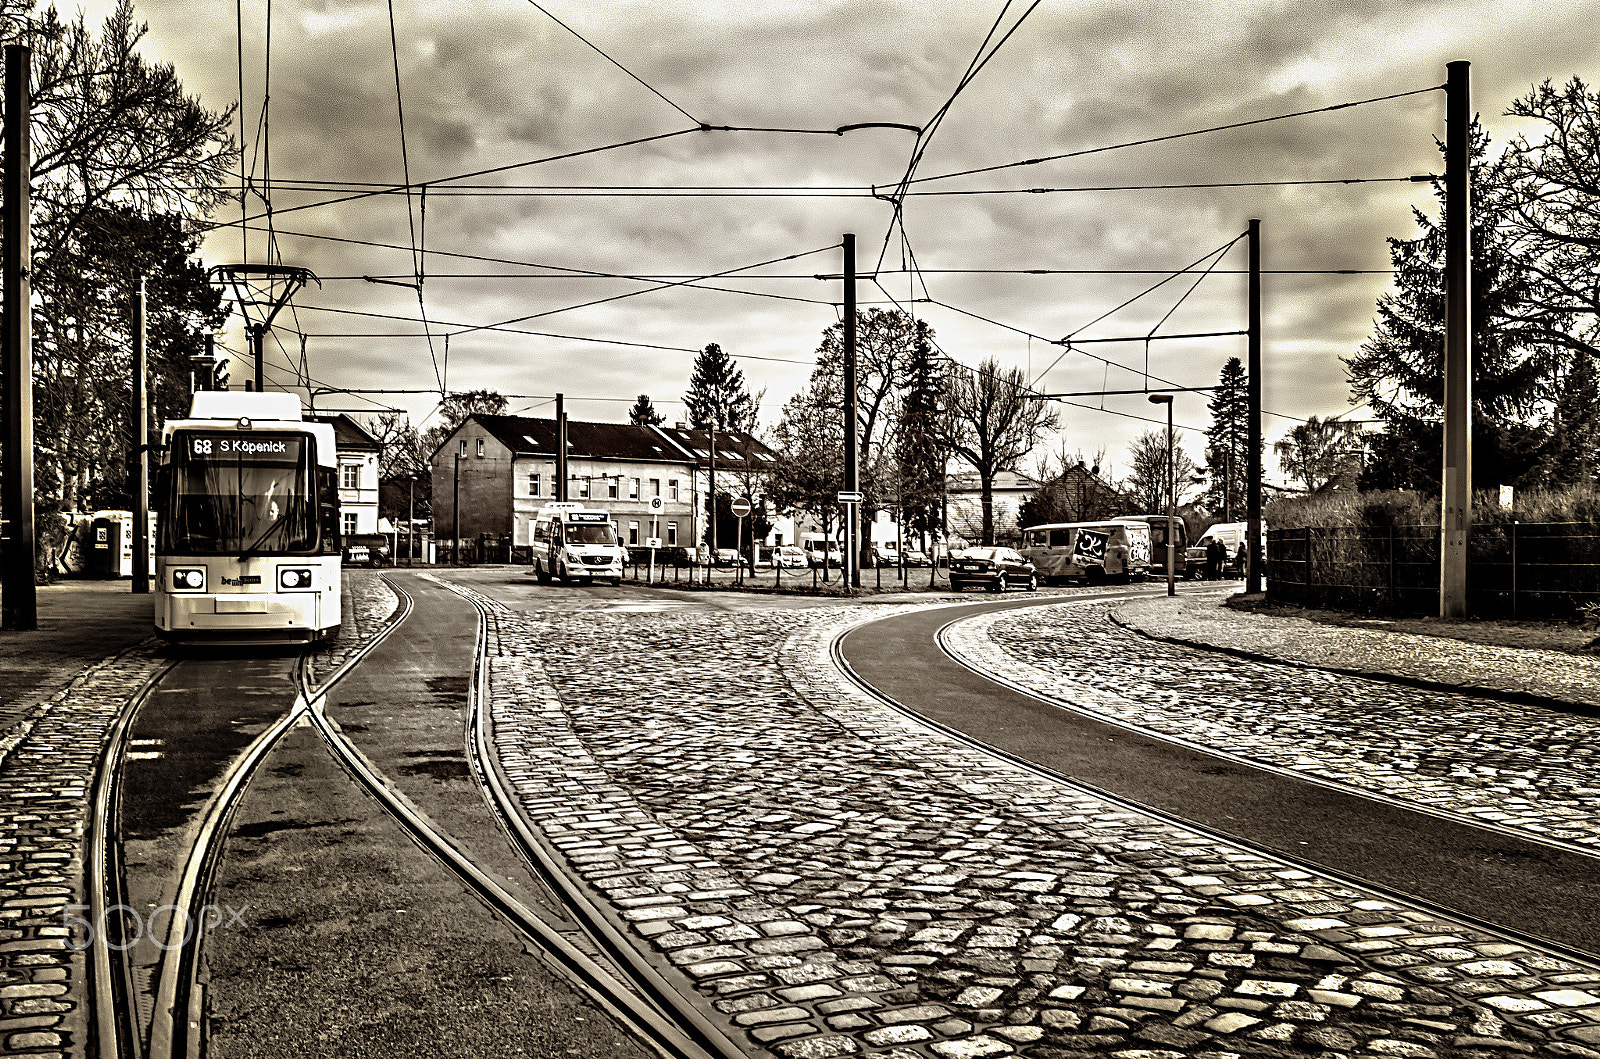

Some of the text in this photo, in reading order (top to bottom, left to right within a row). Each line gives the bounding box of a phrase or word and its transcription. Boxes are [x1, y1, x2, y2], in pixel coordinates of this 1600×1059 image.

[194, 439, 286, 455] 68 S Köpenick
